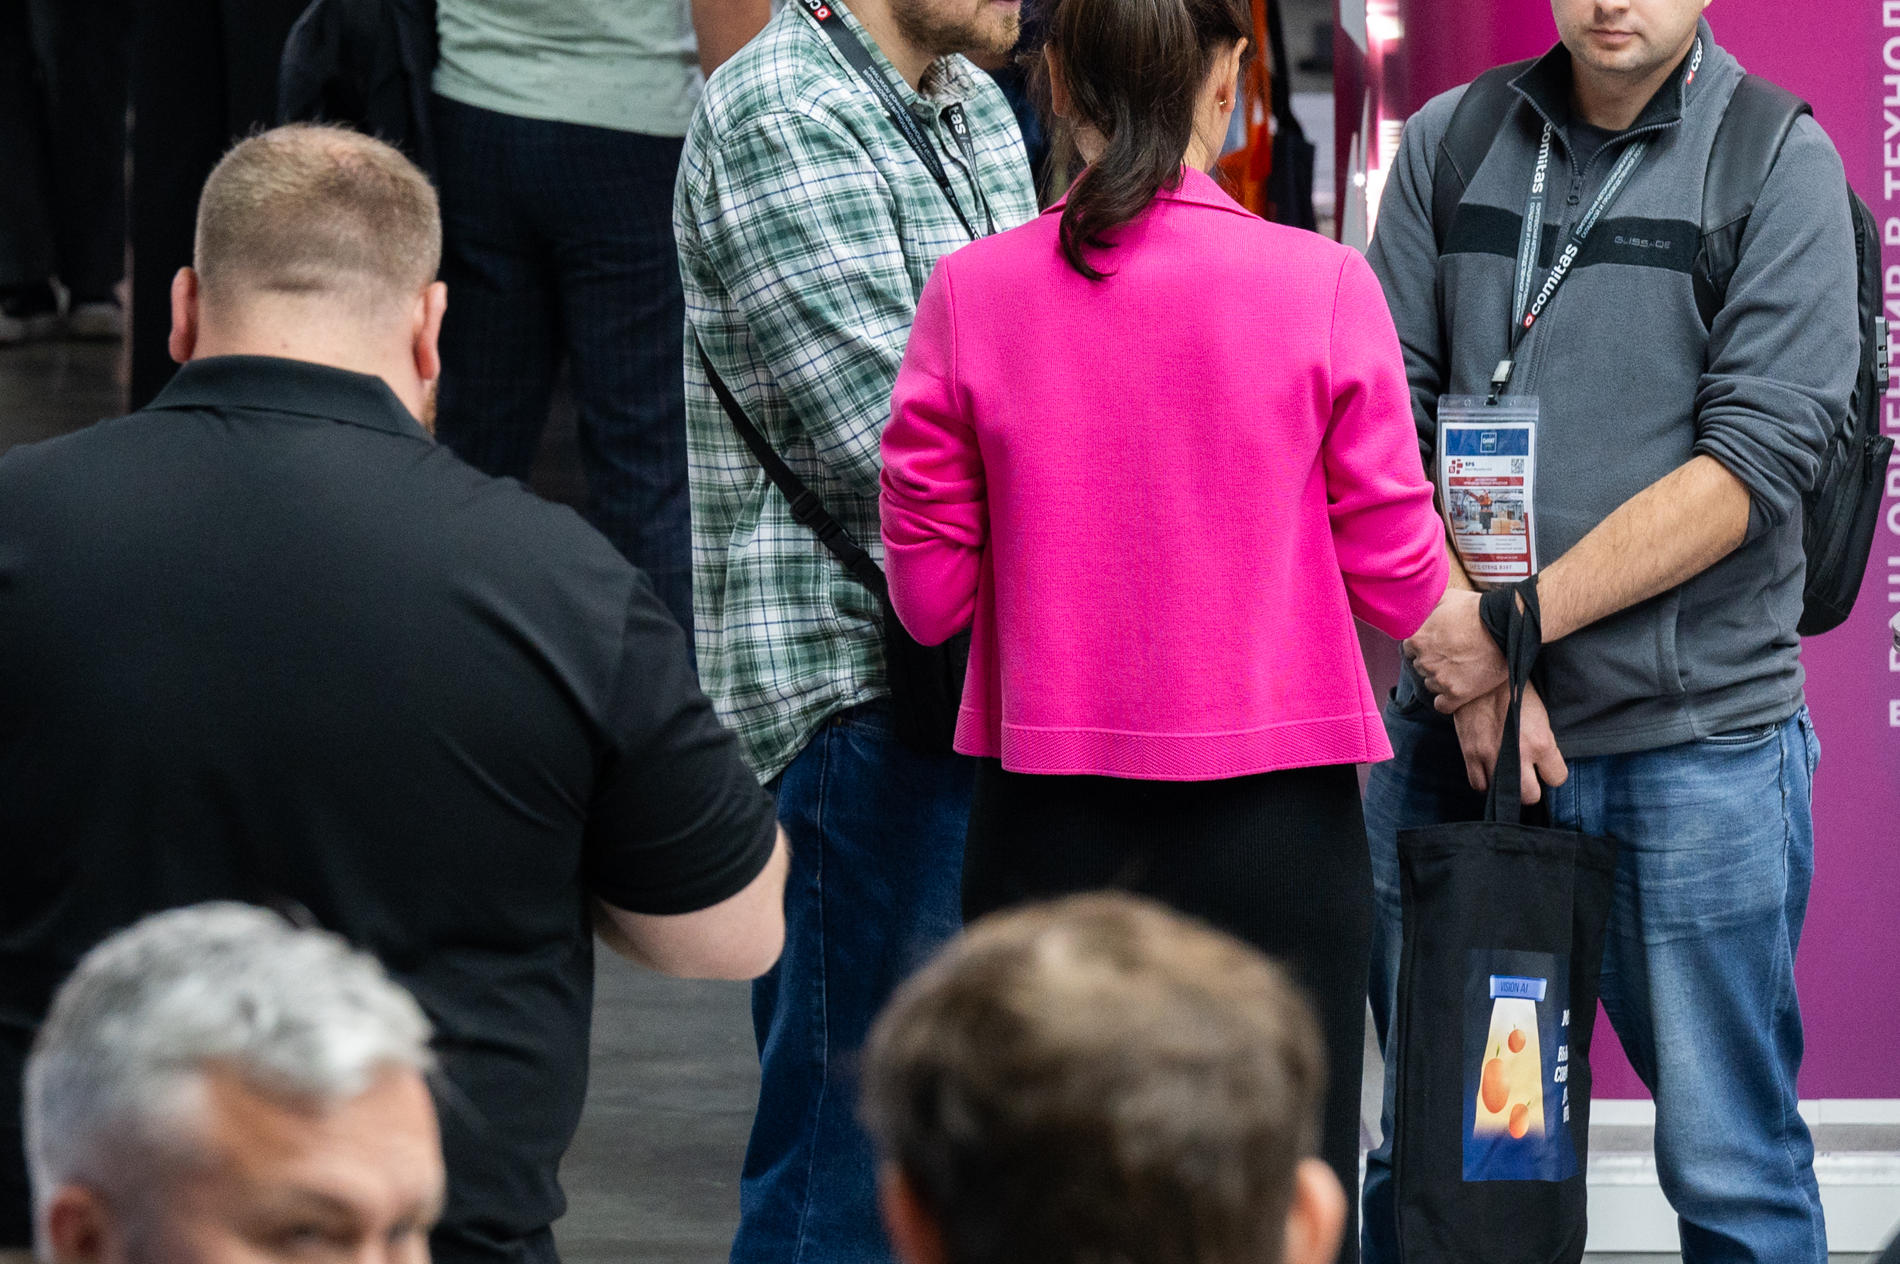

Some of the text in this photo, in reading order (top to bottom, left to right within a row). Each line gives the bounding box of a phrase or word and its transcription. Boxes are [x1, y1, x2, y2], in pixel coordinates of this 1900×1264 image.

[1530, 243, 1579, 316] comitas
[1500, 981, 1529, 994] VISION AI
